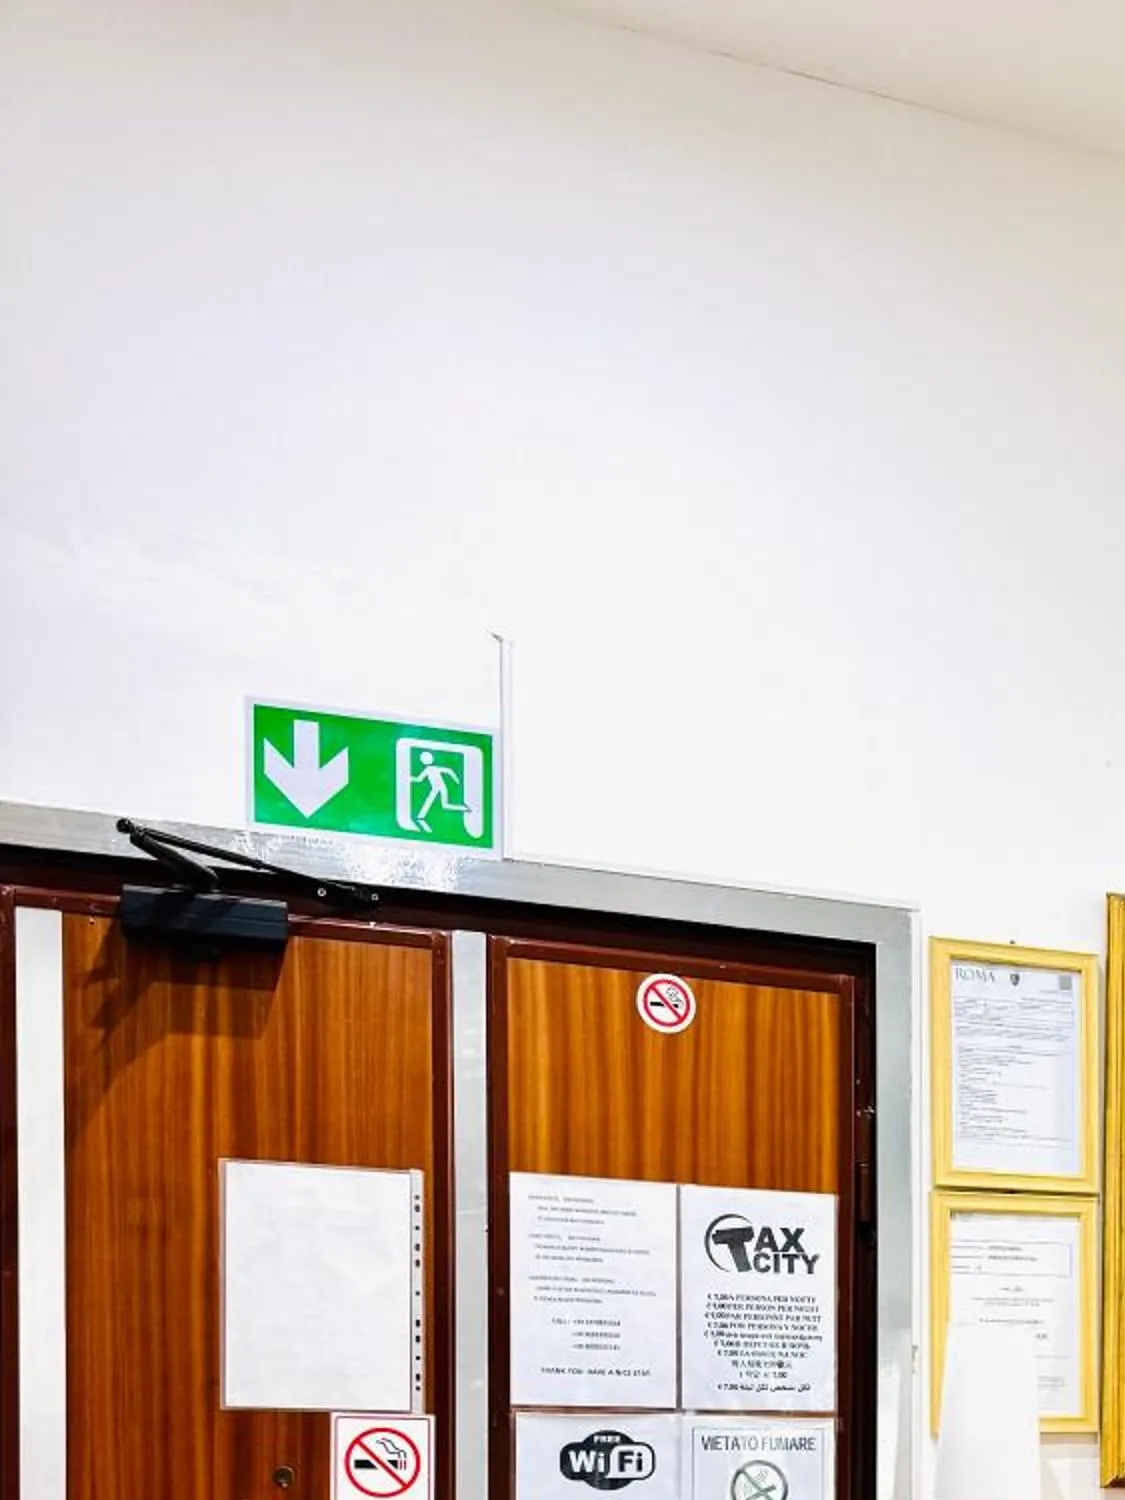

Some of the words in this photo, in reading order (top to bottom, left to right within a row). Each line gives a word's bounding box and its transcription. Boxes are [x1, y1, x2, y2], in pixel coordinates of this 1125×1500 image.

[955, 966, 995, 983] ROMA
[711, 1226, 805, 1273] TAX
[753, 1252, 819, 1275] CITY
[701, 1435, 760, 1451] VIETATO
[761, 1436, 817, 1452] FUMARE
